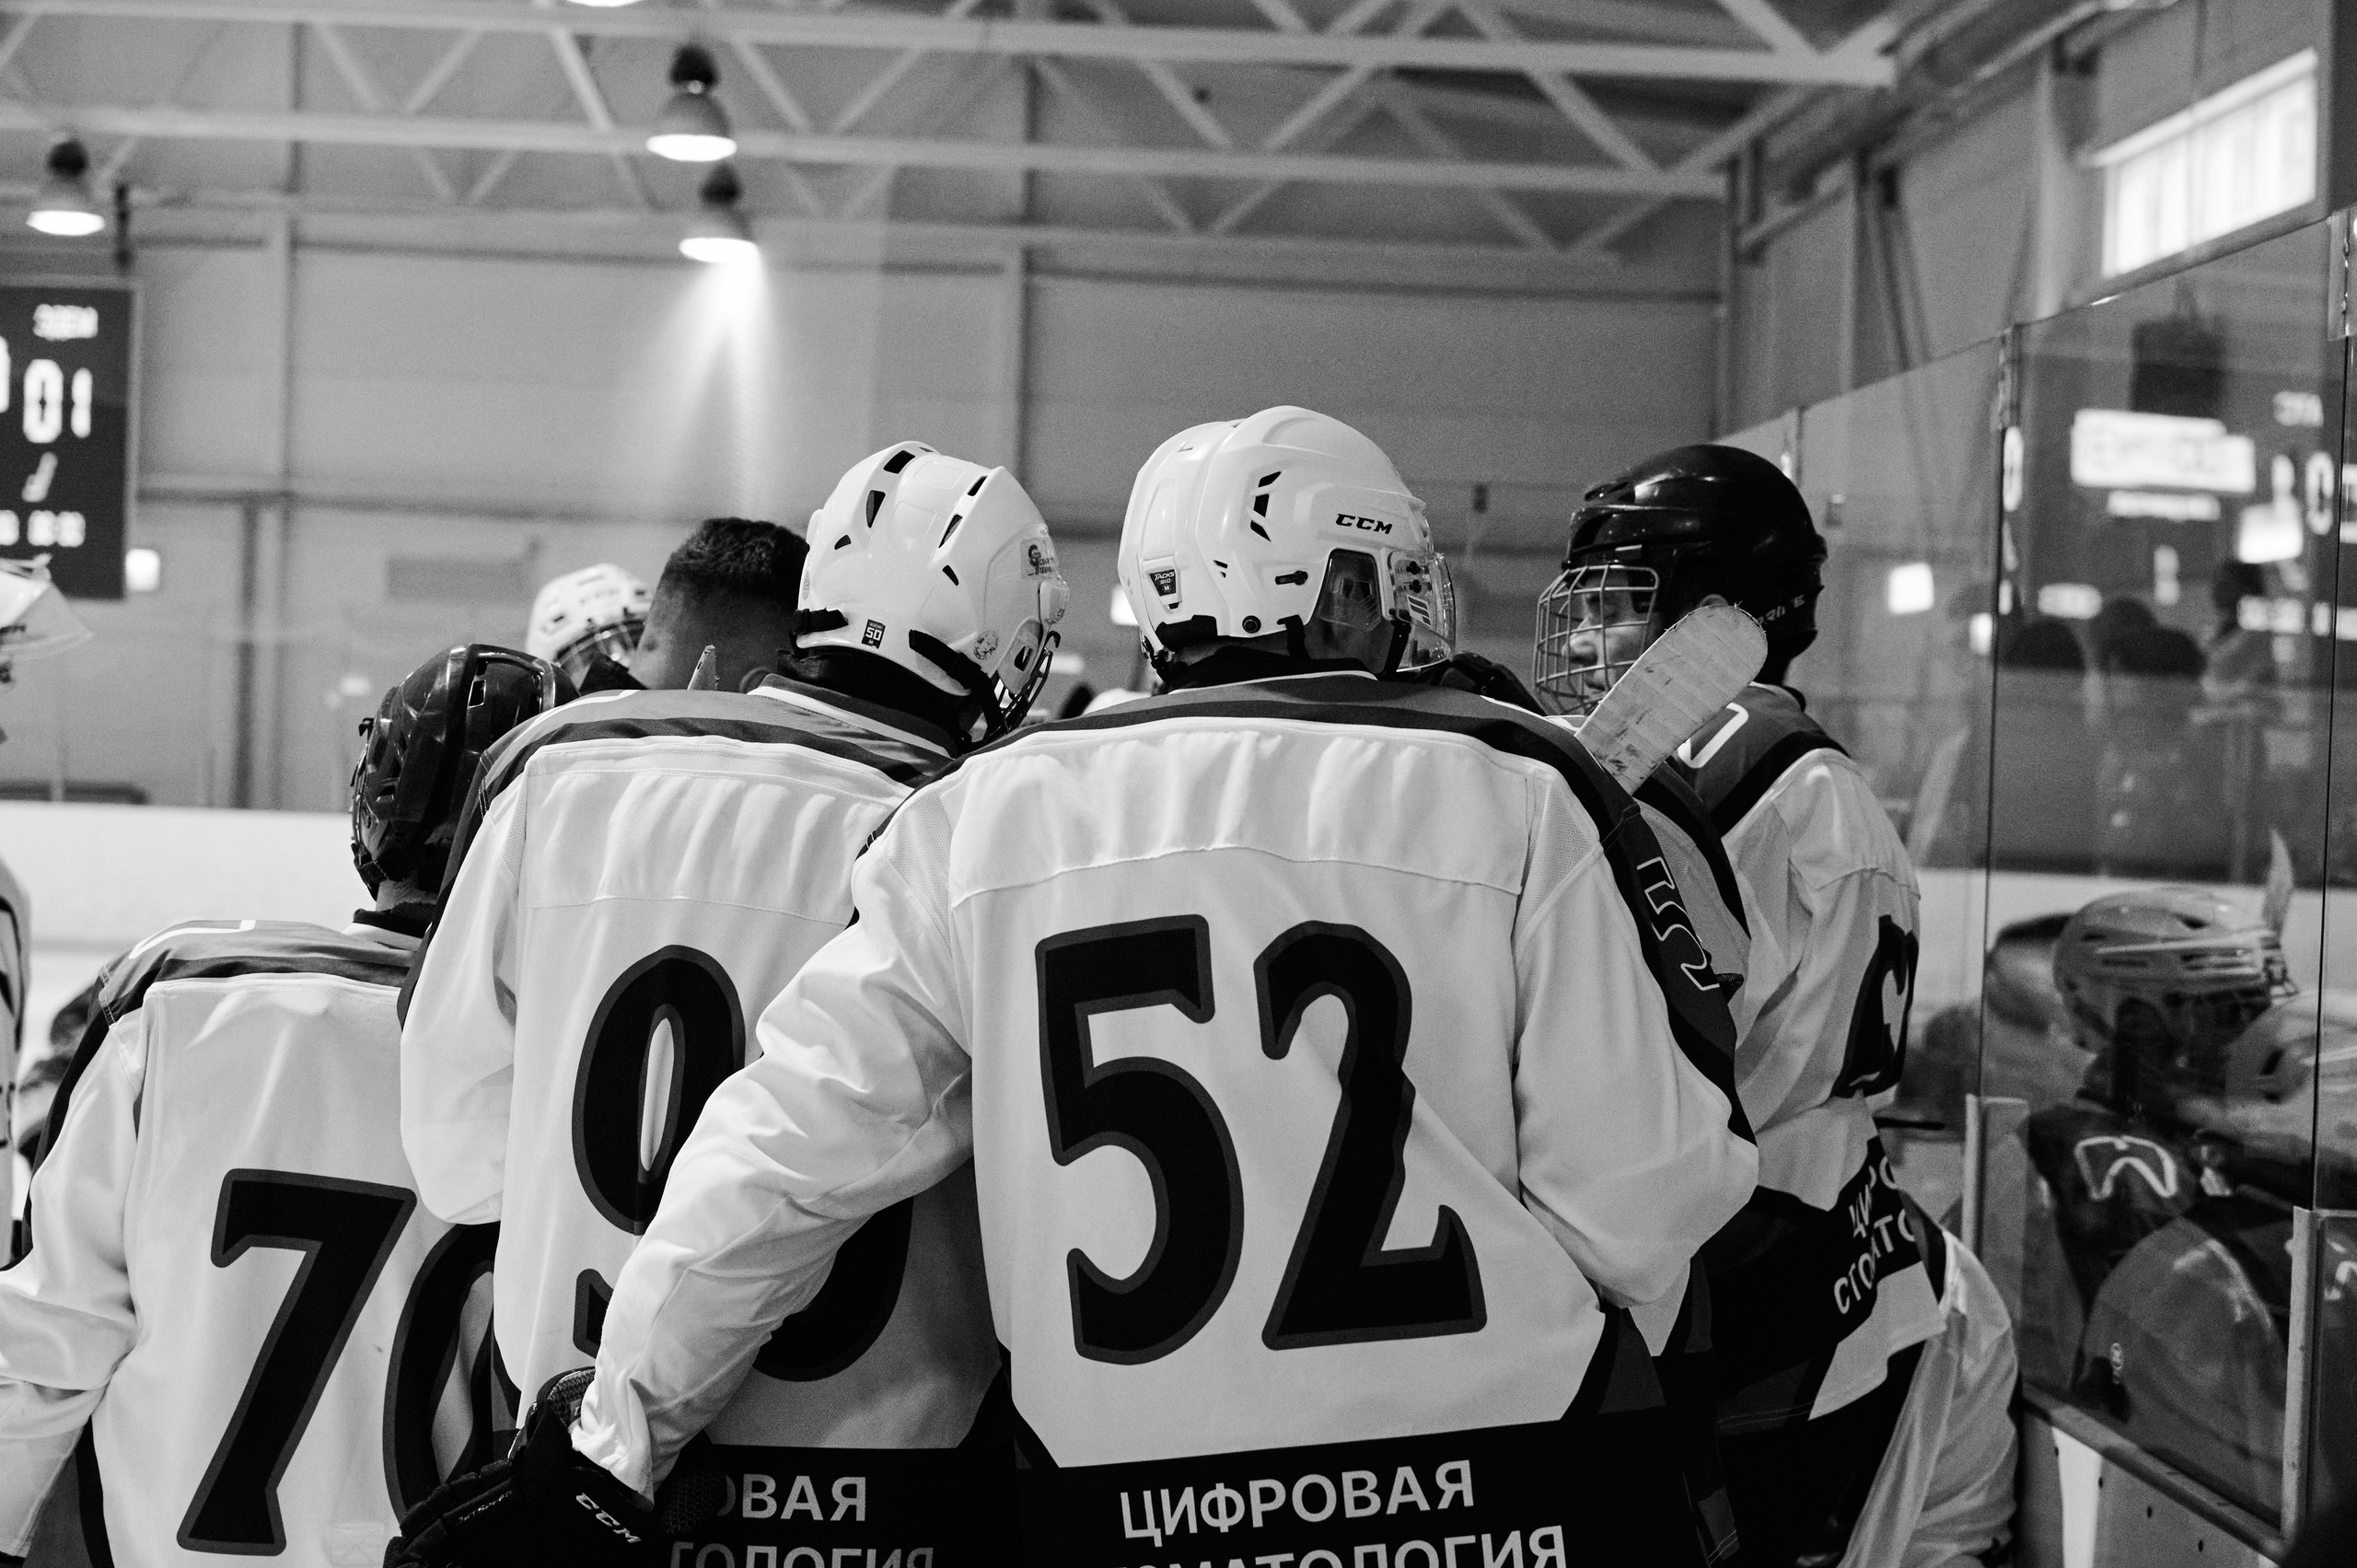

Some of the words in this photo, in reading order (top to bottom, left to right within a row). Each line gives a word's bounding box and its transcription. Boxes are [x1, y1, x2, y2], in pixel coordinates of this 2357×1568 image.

[1335, 513, 1393, 535] CCM
[865, 626, 883, 642] 50
[1034, 913, 1488, 1366] 52
[575, 1492, 643, 1544] CCM
[1120, 1459, 1475, 1548] ЦИФРОВАЯ
